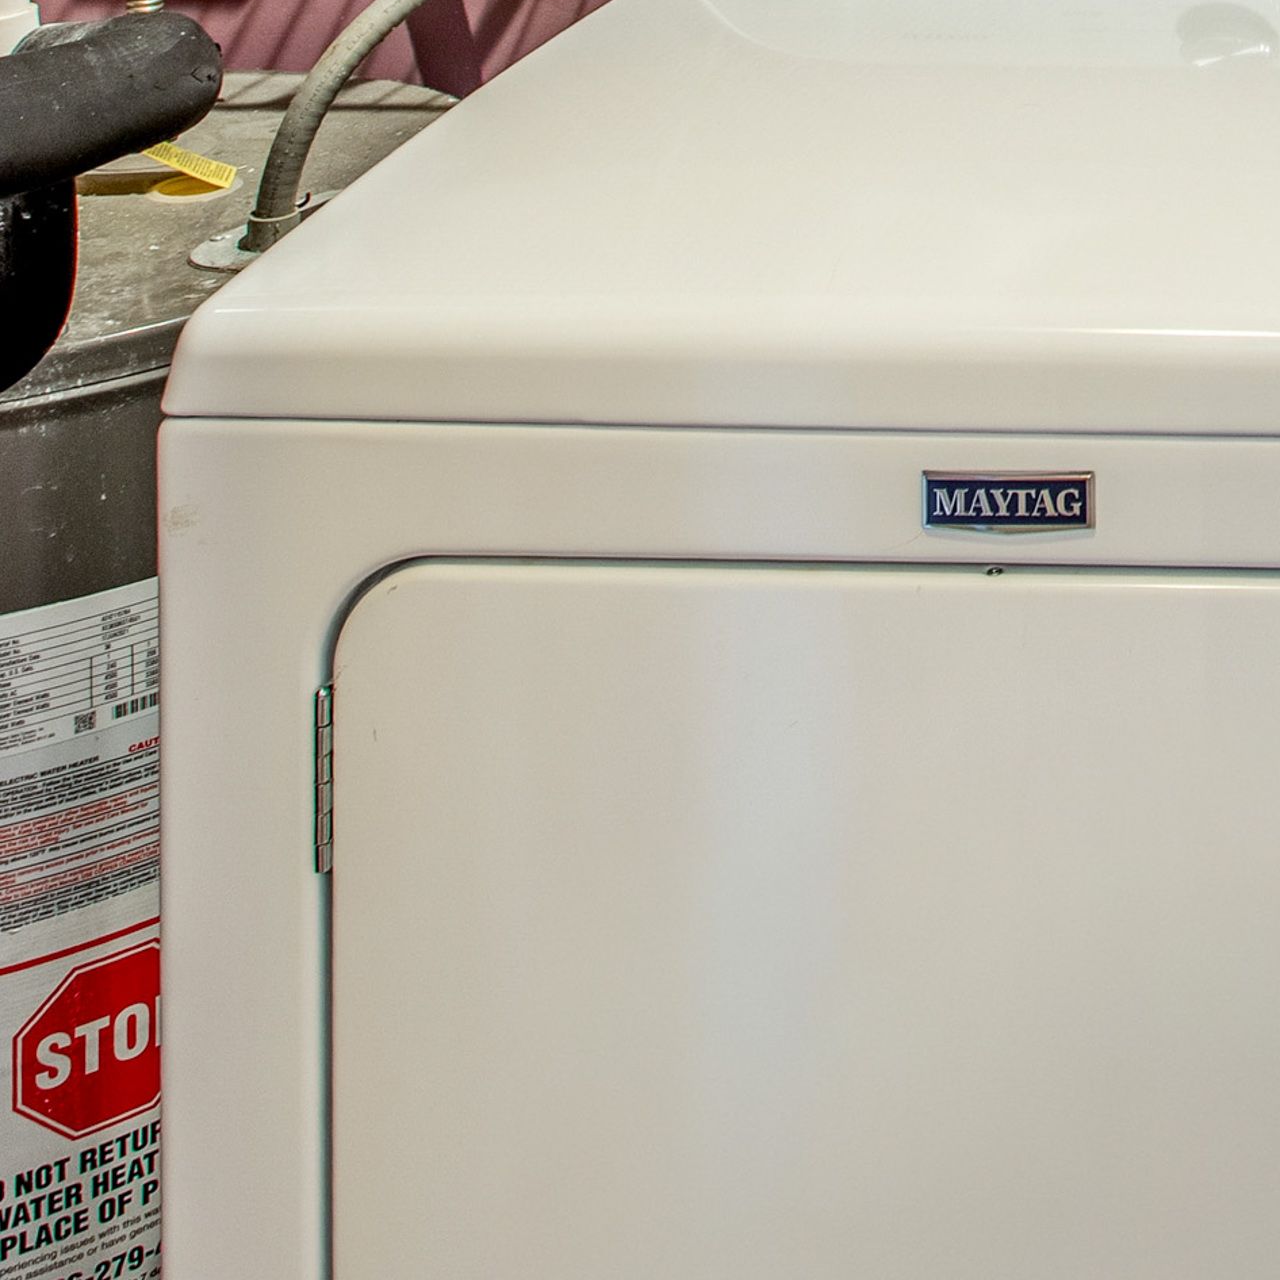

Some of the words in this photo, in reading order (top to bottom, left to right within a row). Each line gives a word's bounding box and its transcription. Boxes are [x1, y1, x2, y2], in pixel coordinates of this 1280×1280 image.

[932, 488, 1082, 517] MAYTAG
[35, 994, 160, 1089] STO
[14, 1156, 70, 1198] NOT
[91, 1149, 159, 1199] HEAT
[0, 1208, 89, 1261] PLACE
[97, 1189, 133, 1225] OF
[60, 1235, 96, 1254] issues
[99, 1224, 120, 1239] with
[123, 1216, 141, 1229] this
[26, 1252, 84, 1278] assistance
[87, 1246, 98, 1256] or
[101, 1233, 127, 1250] have
